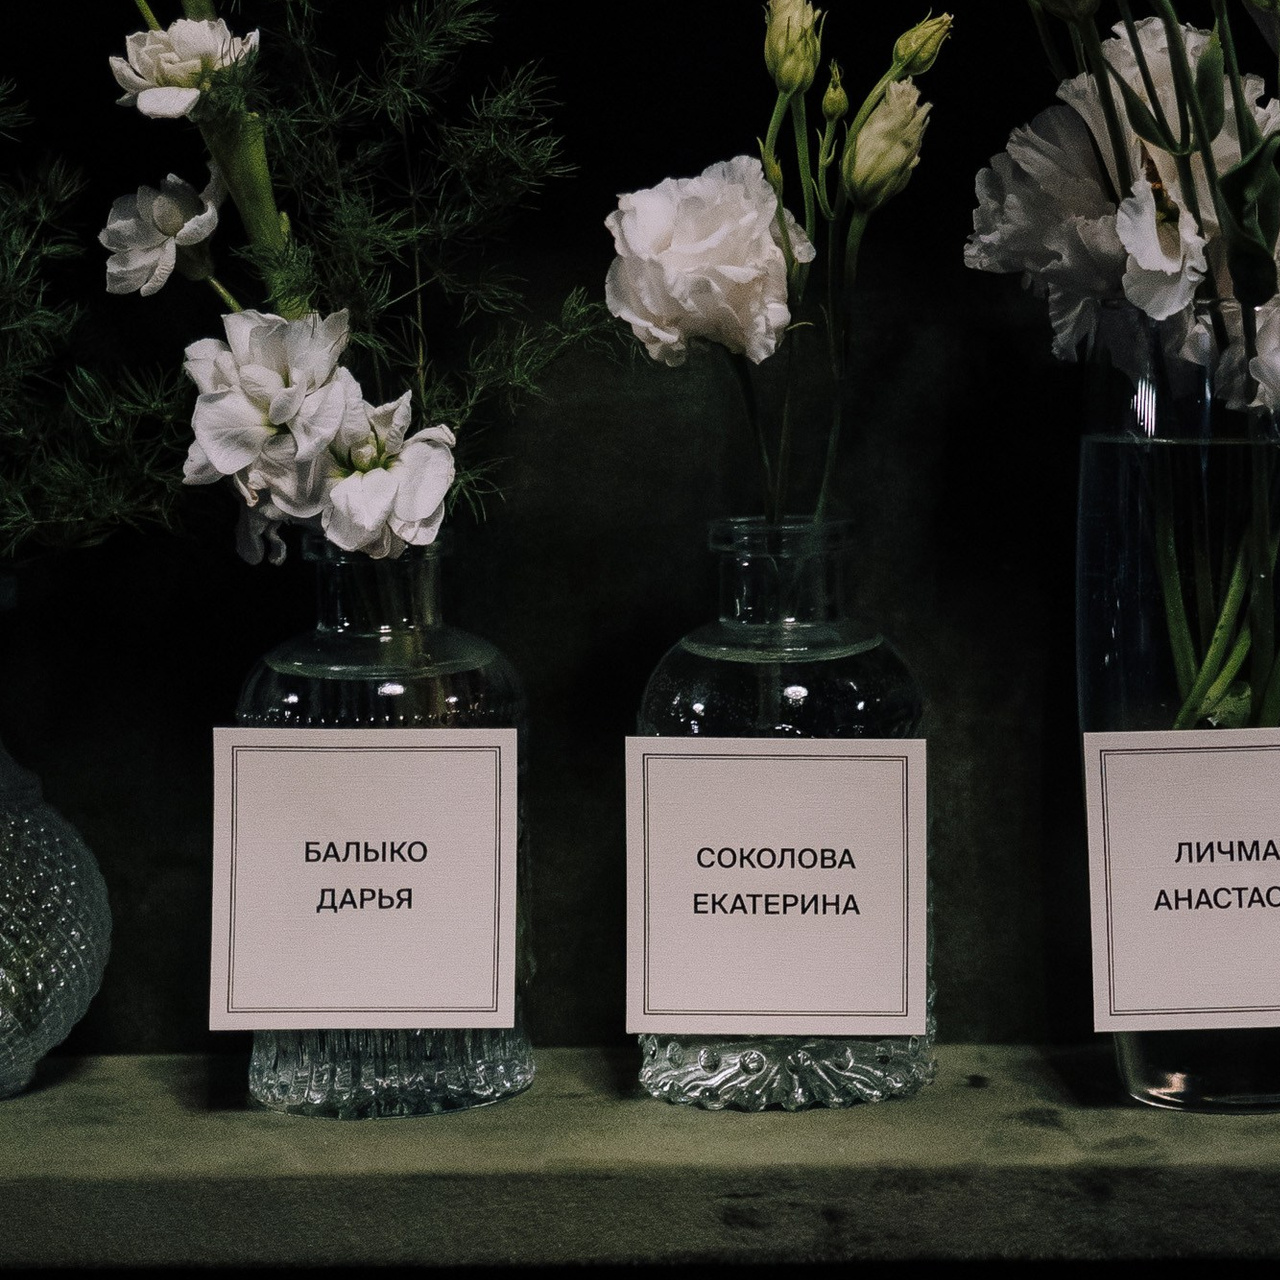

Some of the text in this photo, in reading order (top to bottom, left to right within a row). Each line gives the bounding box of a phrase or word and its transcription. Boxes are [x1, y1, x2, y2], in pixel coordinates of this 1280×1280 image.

[304, 840, 428, 863] БАЛЫКО
[696, 847, 857, 870] СОКОЛОВА
[315, 887, 413, 914] ДАРЬЯ
[693, 893, 861, 916] ЕКАТЕРИНА
